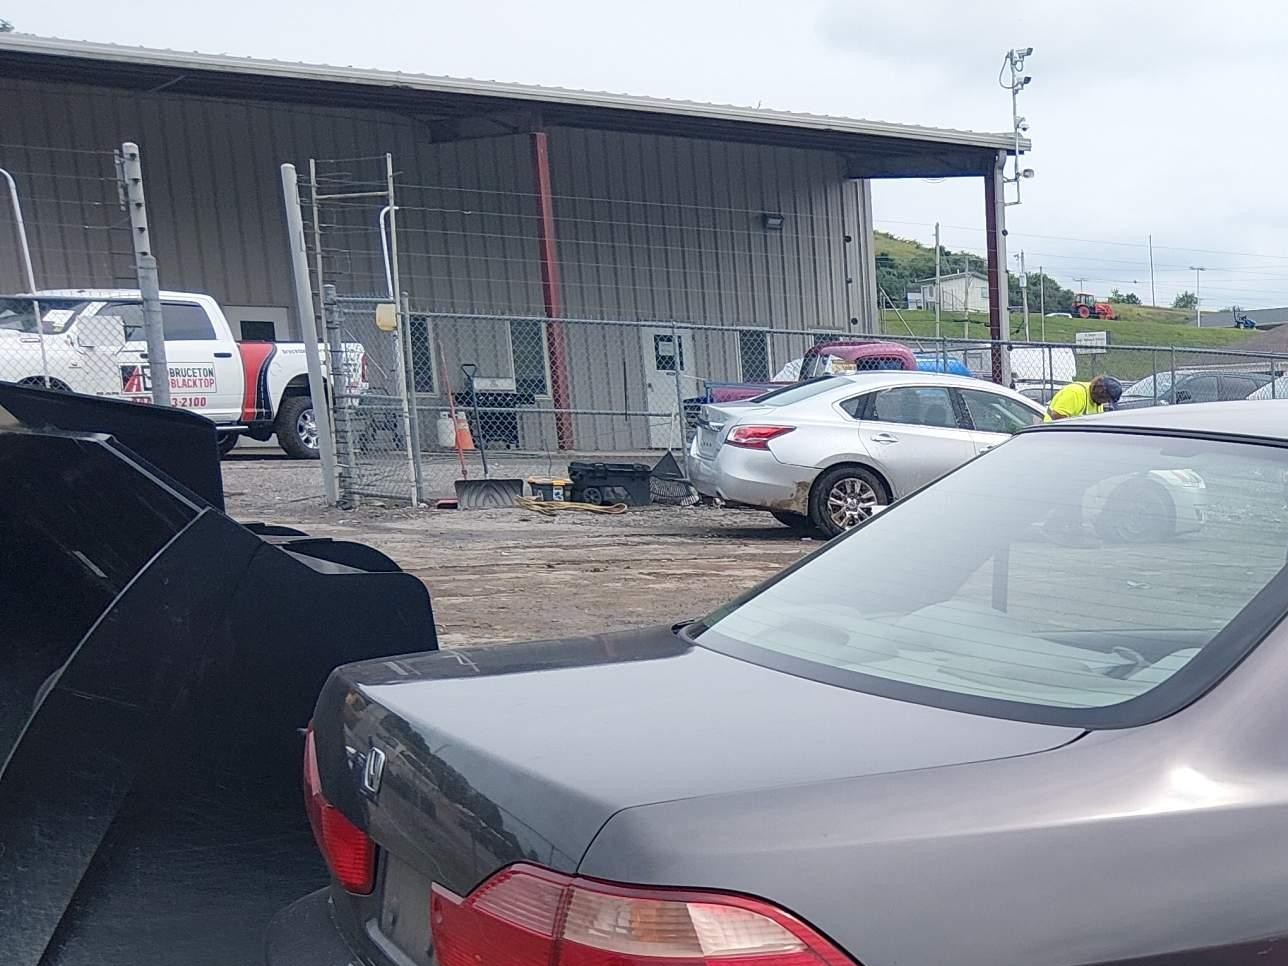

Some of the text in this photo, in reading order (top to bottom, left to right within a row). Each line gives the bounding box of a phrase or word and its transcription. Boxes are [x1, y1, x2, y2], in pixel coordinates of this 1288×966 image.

[169, 367, 214, 378] BRUCETON
[170, 378, 215, 389] BLACKTOP
[171, 397, 207, 408] 3-2100
